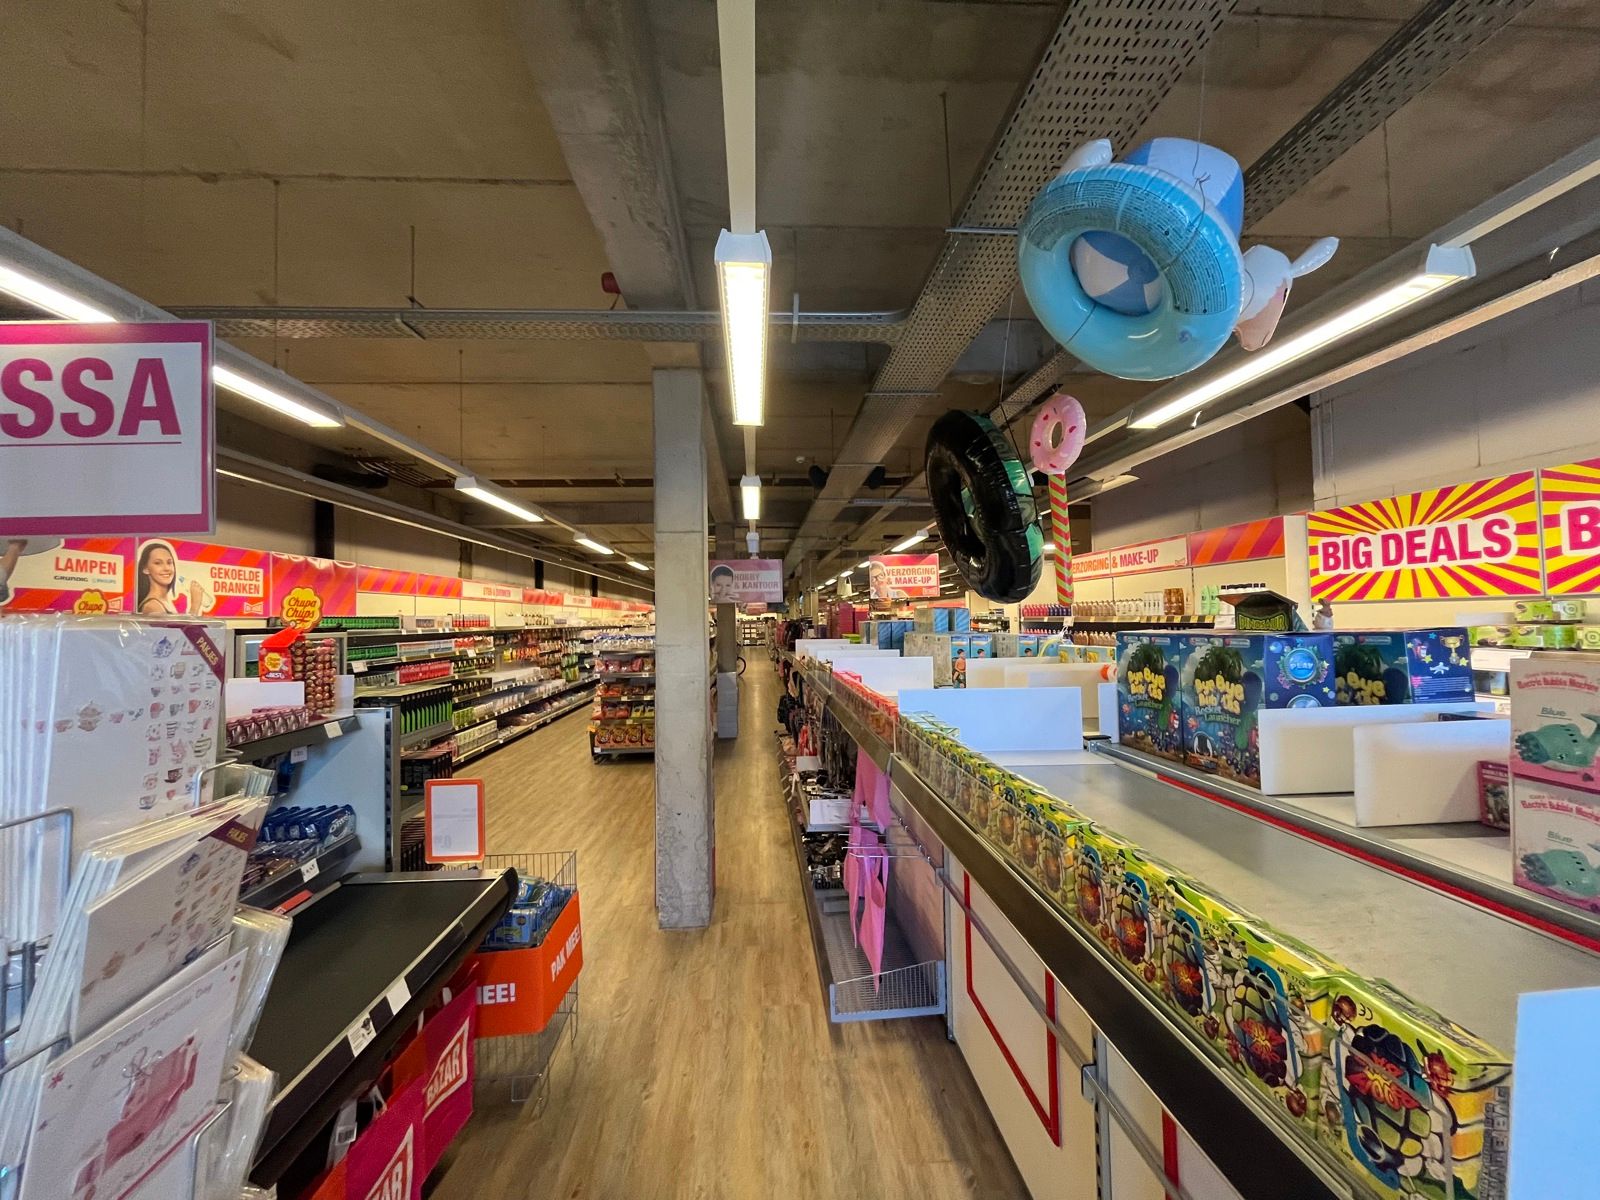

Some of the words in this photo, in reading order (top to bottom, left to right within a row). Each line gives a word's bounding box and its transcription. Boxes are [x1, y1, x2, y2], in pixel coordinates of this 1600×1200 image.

[1321, 536, 1373, 572] BIG
[1381, 517, 1512, 568] DEALS
[55, 556, 117, 576] LAMPEN
[1072, 557, 1109, 575] ERZORGING
[1111, 556, 1118, 569] &
[1120, 548, 1159, 568] MAKE-UP
[210, 566, 261, 582] GEKOELDE
[886, 567, 936, 577] VERZORGING
[213, 580, 260, 595] DRANKEN
[742, 581, 779, 590] KANTOOR
[895, 575, 932, 585] MAKE-UP
[287, 597, 317, 611] Chupa
[285, 608, 315, 620] Chups
[1239, 614, 1287, 631] DINOSAUR
[1290, 662, 1314, 670] PLAY
[551, 946, 567, 983] PAK
[426, 1041, 462, 1108] BAZAR
